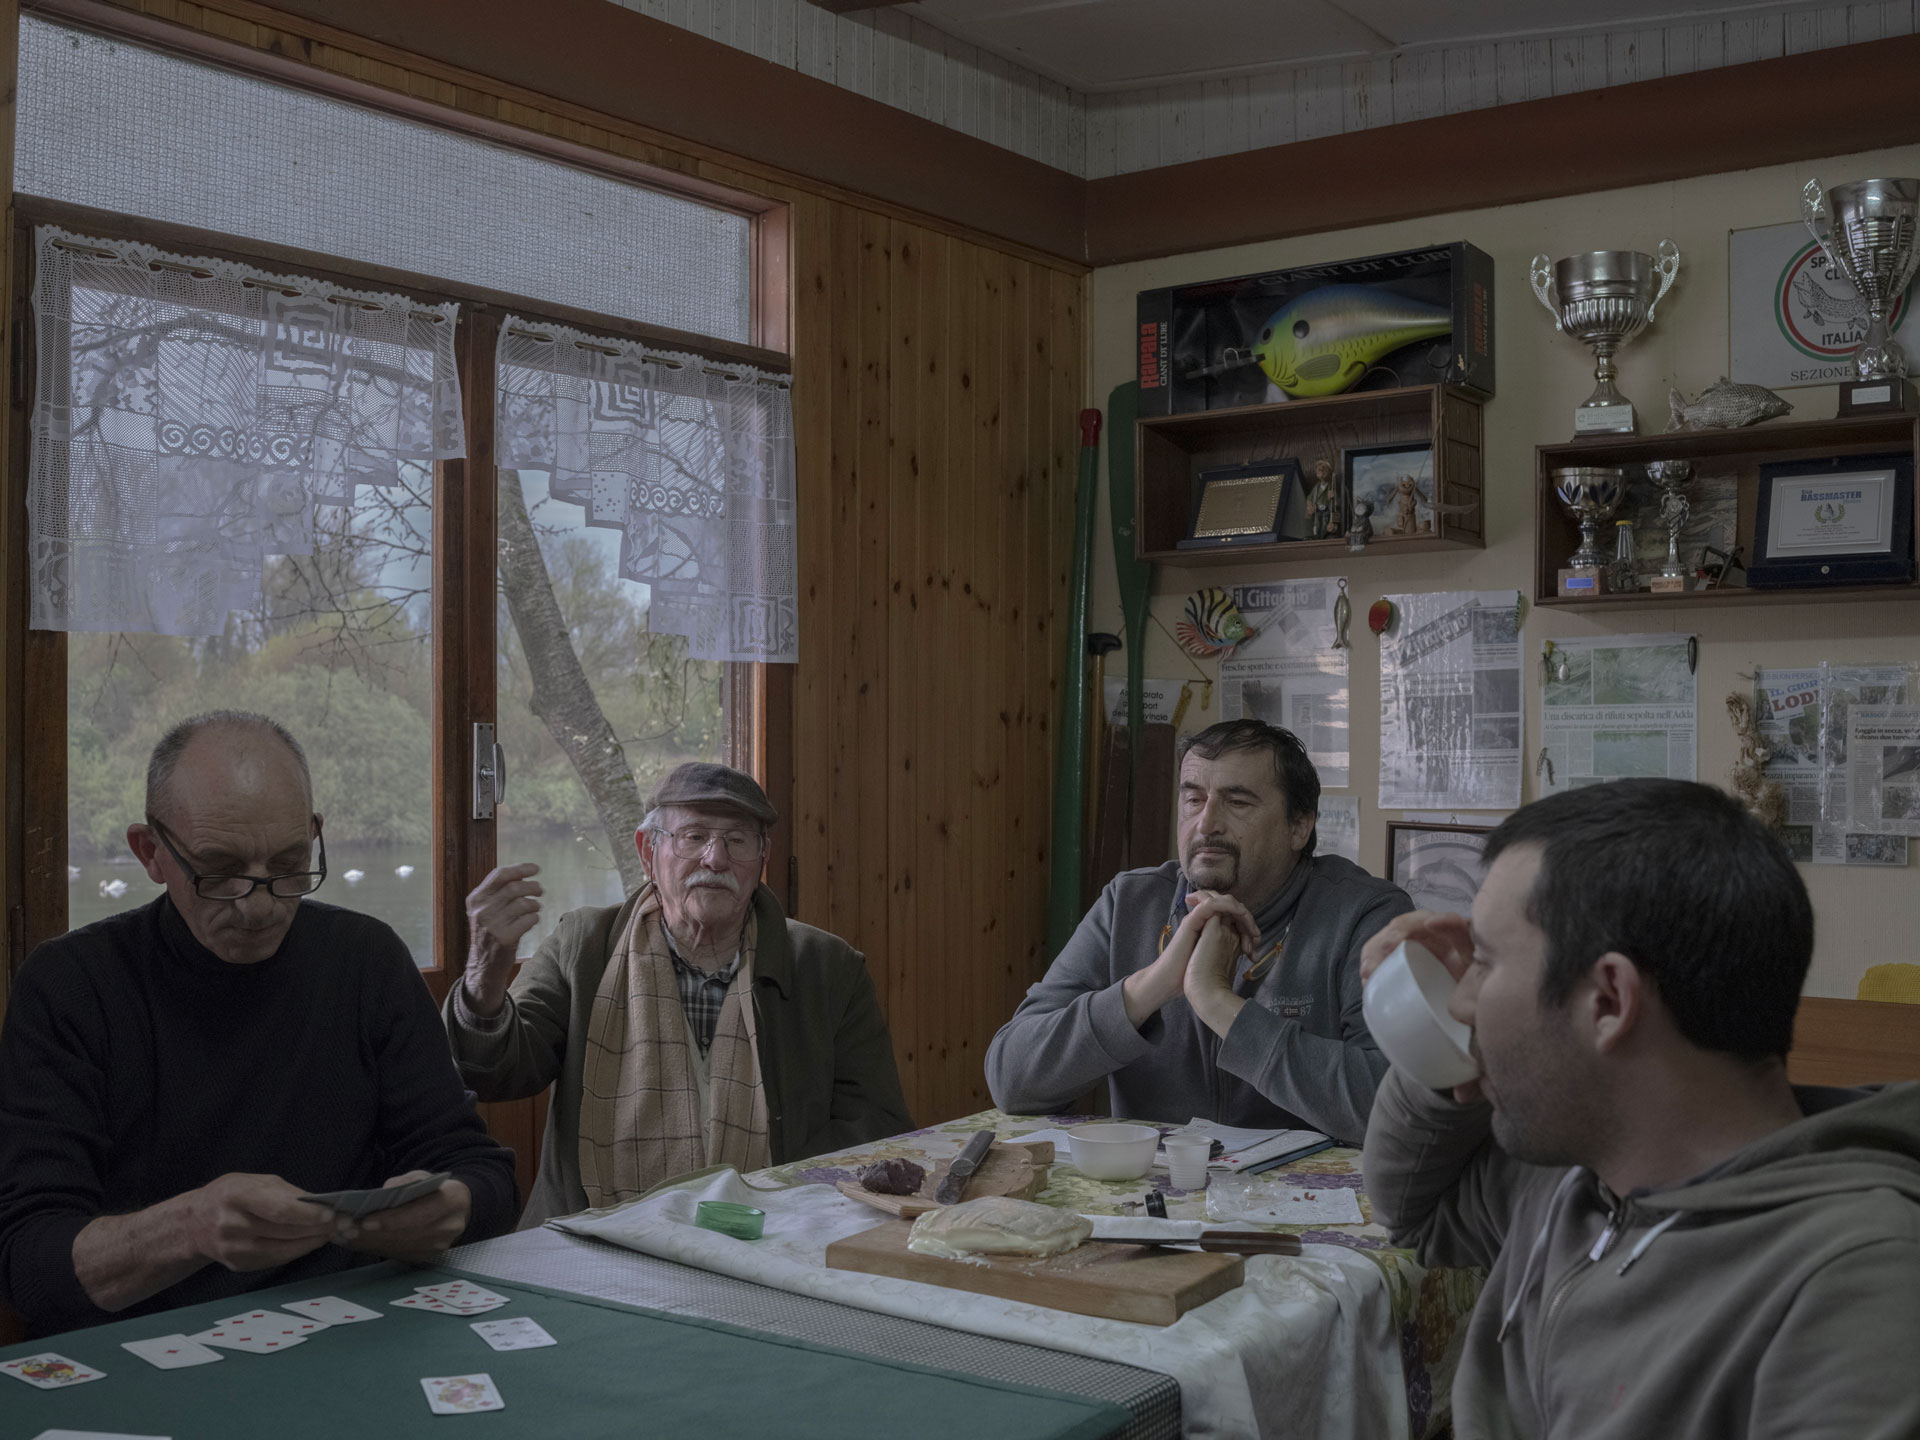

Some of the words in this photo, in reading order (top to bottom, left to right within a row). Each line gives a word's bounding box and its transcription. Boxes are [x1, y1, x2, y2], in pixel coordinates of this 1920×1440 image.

[1260, 266, 1340, 286] GIANT
[1345, 260, 1386, 274] DT
[1825, 269, 1845, 280] CL
[1160, 321, 1168, 344] LURE
[1822, 331, 1863, 345] ITALIA
[1160, 345, 1168, 358] DT
[1160, 359, 1168, 386] GIANT
[1801, 491, 1862, 502] BASSMASTER
[1234, 589, 1243, 608] il
[1247, 586, 1309, 607] Cittadino
[1770, 688, 1784, 697] IL
[1787, 680, 1819, 693] GIOR
[1544, 712, 1559, 720] Una
[1561, 711, 1594, 720] discarica
[1595, 711, 1603, 720] di
[1604, 711, 1625, 720] rifiuti
[1627, 710, 1654, 722] sepolta
